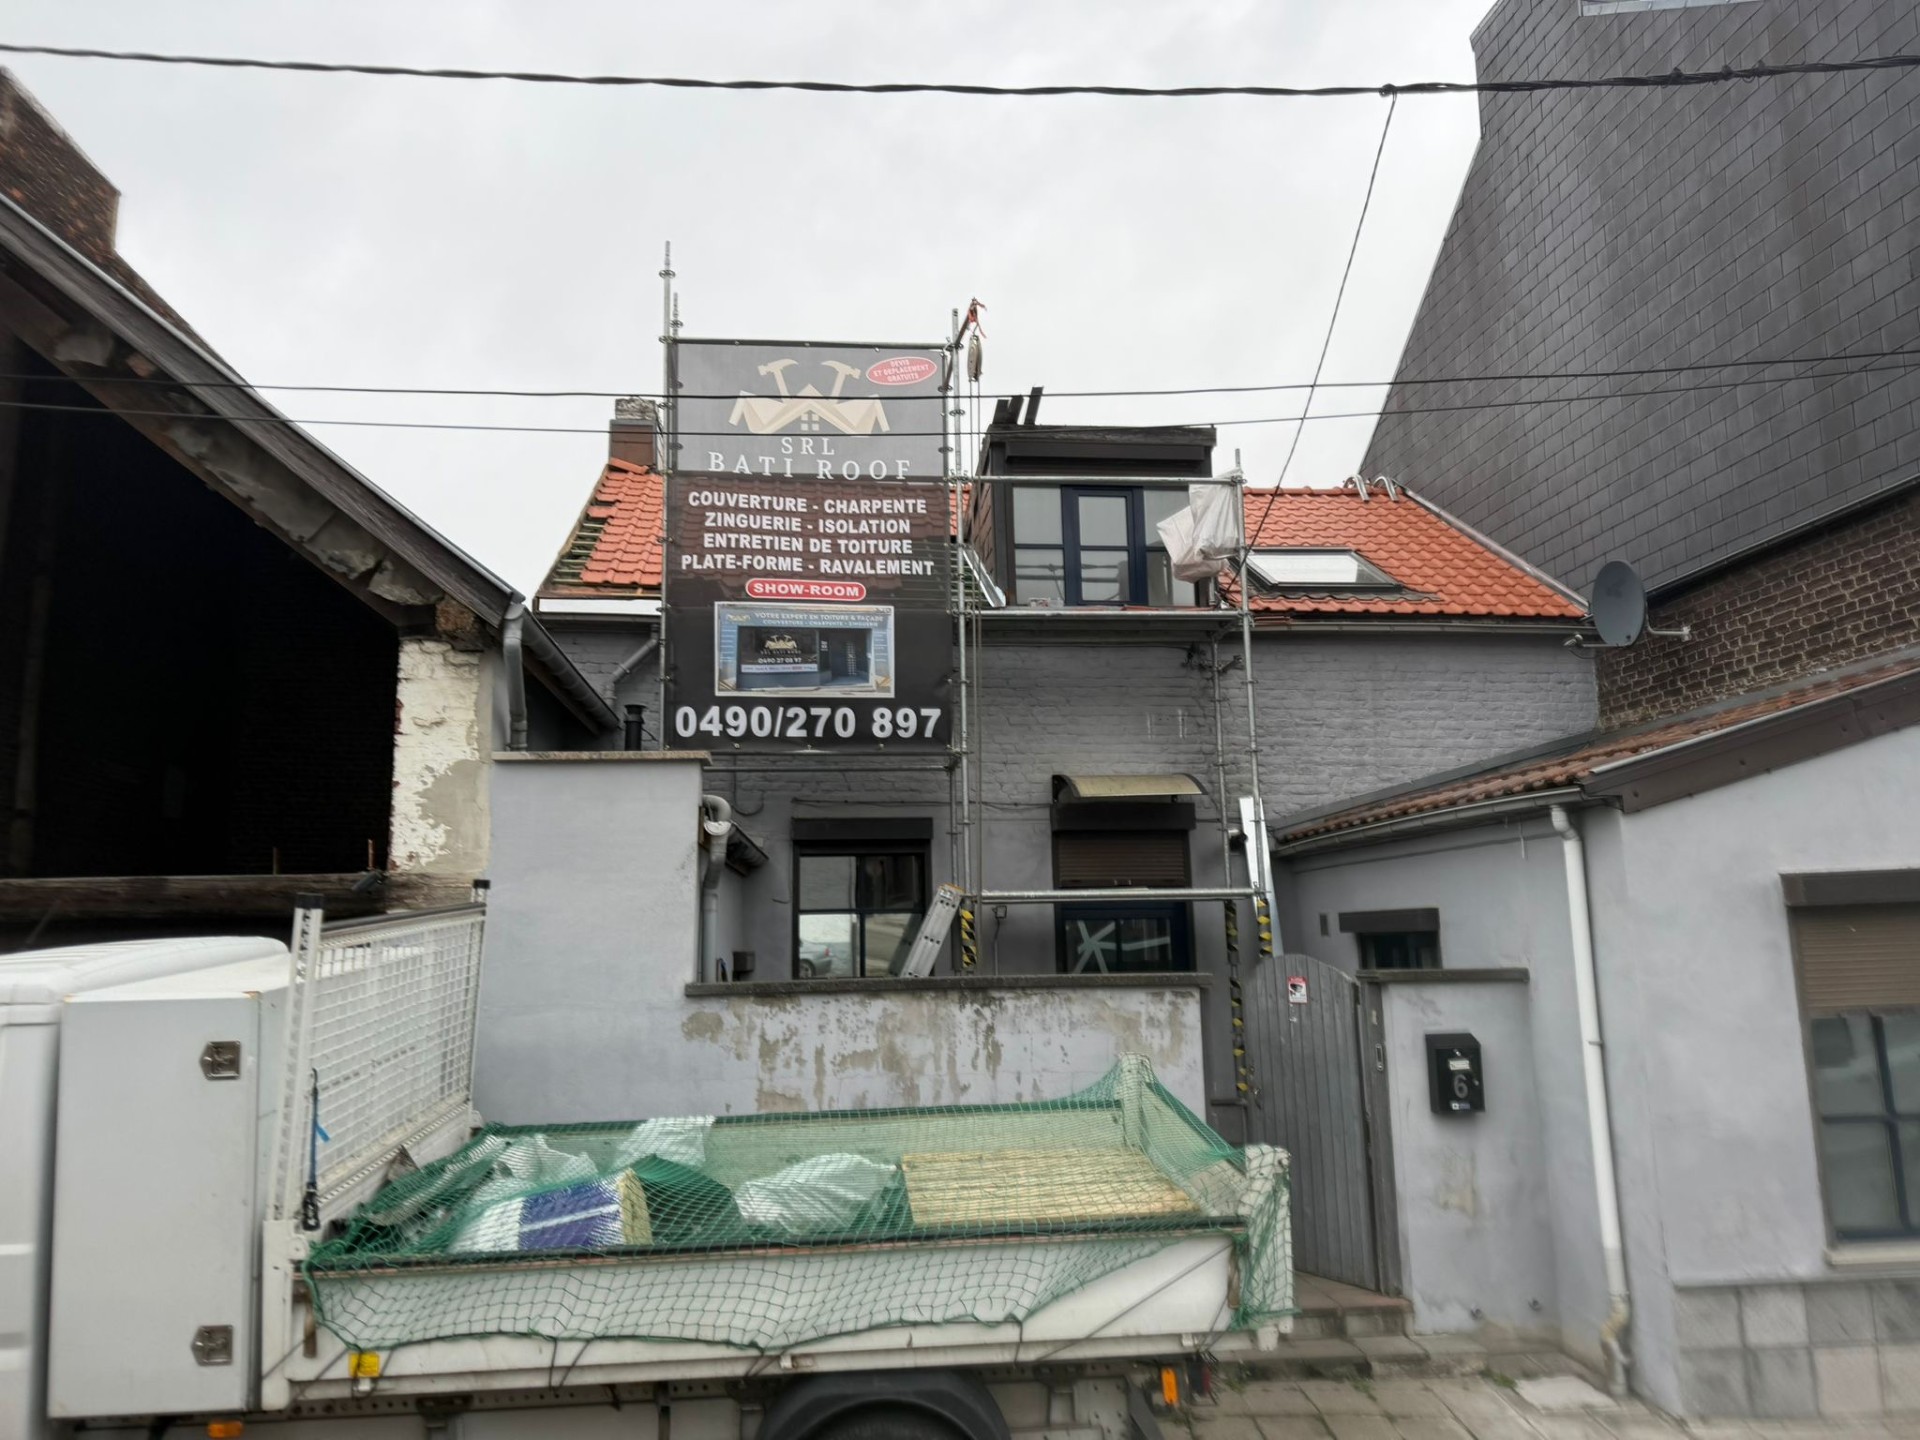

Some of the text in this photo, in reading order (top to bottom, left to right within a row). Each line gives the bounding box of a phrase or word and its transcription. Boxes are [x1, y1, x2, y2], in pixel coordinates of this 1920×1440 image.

[781, 436, 835, 455] SRL
[708, 451, 911, 481] BATI ROOF
[688, 491, 808, 513] COUVERTURE
[824, 498, 927, 514] CHARPENTE
[704, 512, 802, 532] ZINGUERIE
[818, 519, 911, 534] ISOLATION
[703, 532, 913, 554] ENTRETIEN DE TOITURE
[681, 554, 803, 572] PLATE-FORME
[820, 558, 935, 575] RAVALEMENT
[753, 583, 859, 597] SHOW-ROOM
[675, 706, 942, 738] 0490/270 897
[1453, 1074, 1469, 1099] 6
